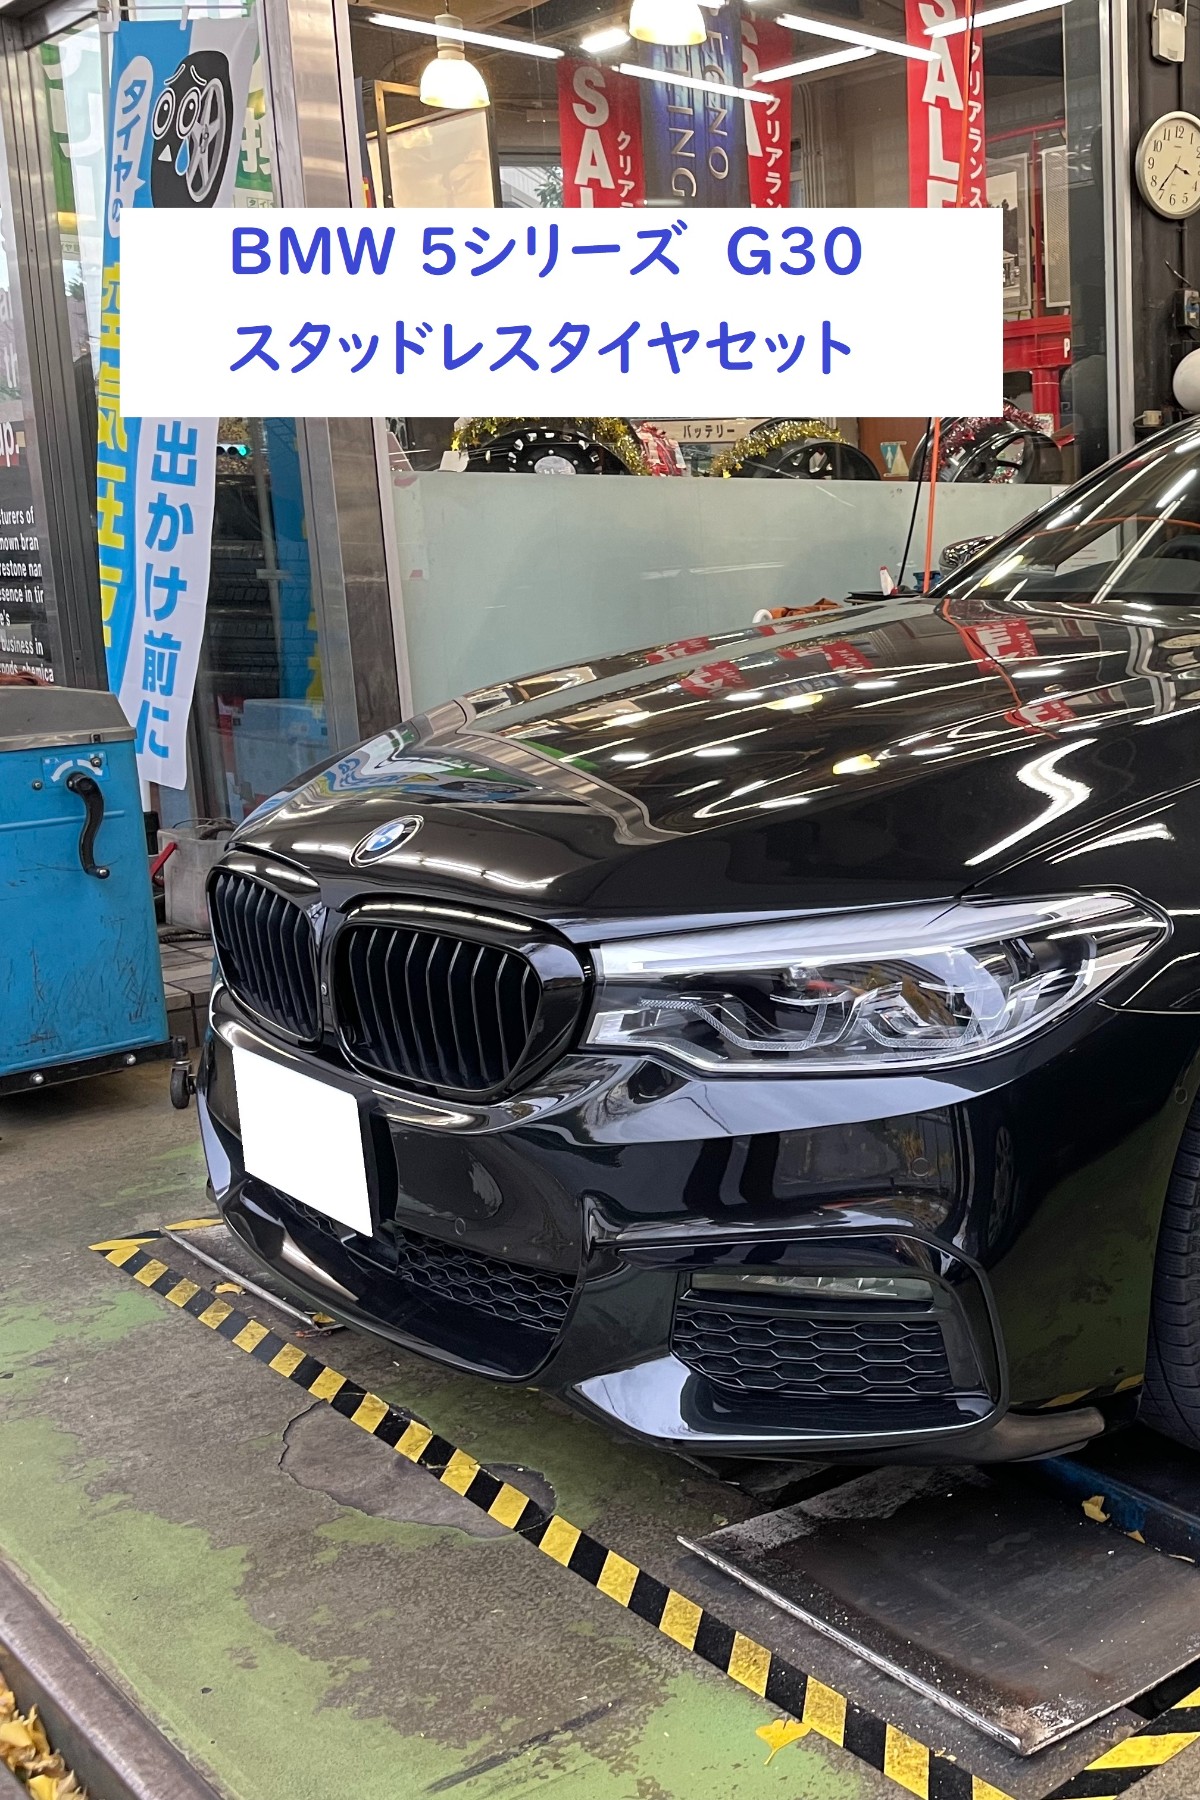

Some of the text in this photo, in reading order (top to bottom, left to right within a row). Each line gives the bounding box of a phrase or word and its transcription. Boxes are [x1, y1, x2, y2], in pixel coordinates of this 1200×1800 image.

[1163, 127, 1171, 141] 11
[1175, 125, 1185, 139] 12
[1153, 139, 1163, 152] 10
[1147, 157, 1155, 170] 9
[1150, 175, 1158, 187] 8
[1169, 193, 1176, 206] 6
[1182, 192, 1189, 204] 5
[683, 424, 735, 439] バッテリー
[26, 505, 34, 524] of
[24, 584, 33, 603] in
[136, 420, 198, 758] 出かけ前に
[1, 636, 44, 656] business in
